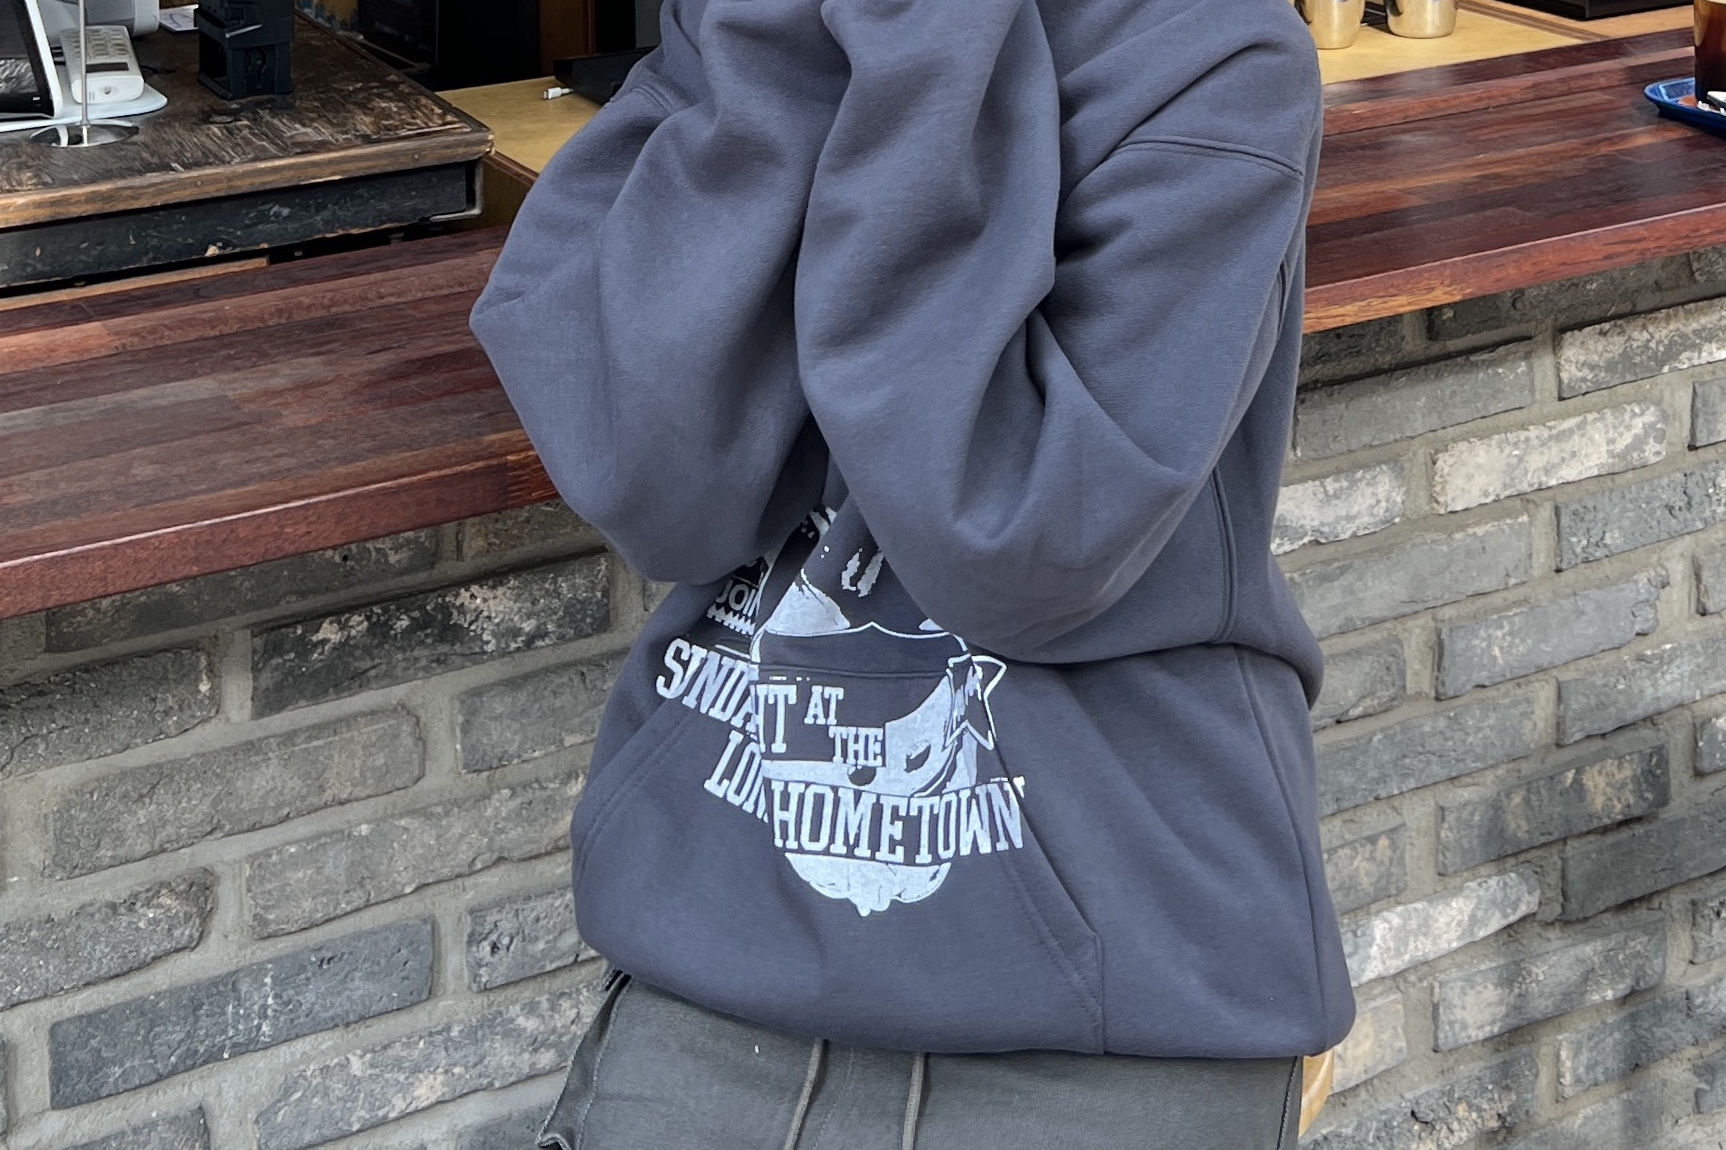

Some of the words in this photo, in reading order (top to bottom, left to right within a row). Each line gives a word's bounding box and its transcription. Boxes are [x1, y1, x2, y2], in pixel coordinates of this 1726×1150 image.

[804, 685, 845, 726] AT
[829, 727, 884, 767] THE
[770, 776, 1026, 864] HOMETOWN
